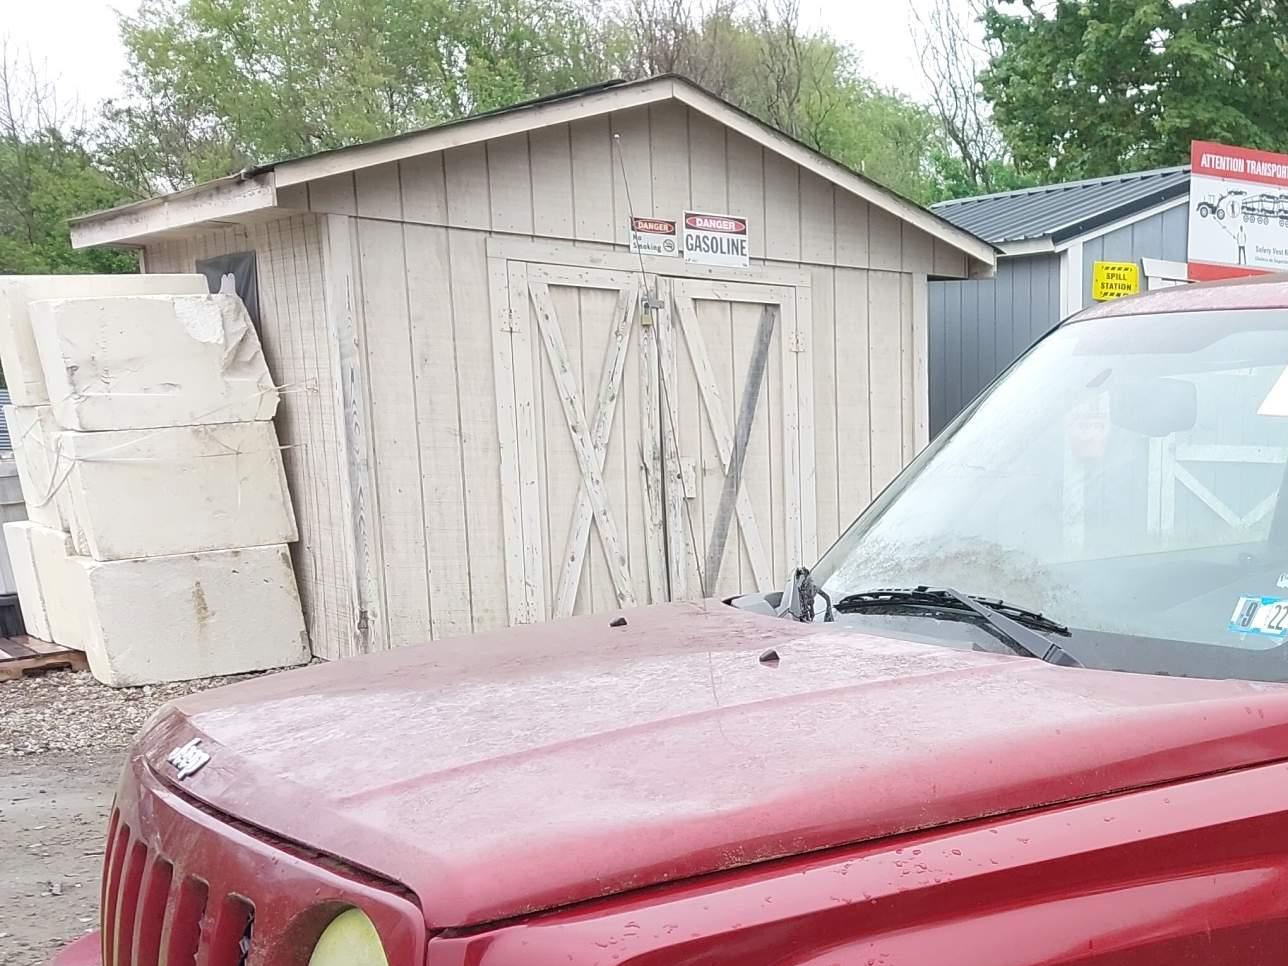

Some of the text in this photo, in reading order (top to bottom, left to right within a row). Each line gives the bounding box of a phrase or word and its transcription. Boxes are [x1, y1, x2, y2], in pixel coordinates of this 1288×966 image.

[1200, 153, 1244, 173] ATTENTION
[639, 220, 669, 232] DANGER
[695, 218, 736, 231] DANGER
[685, 233, 747, 257] GASOLINE
[1105, 272, 1127, 281] SPILL
[1100, 282, 1132, 291] STATION
